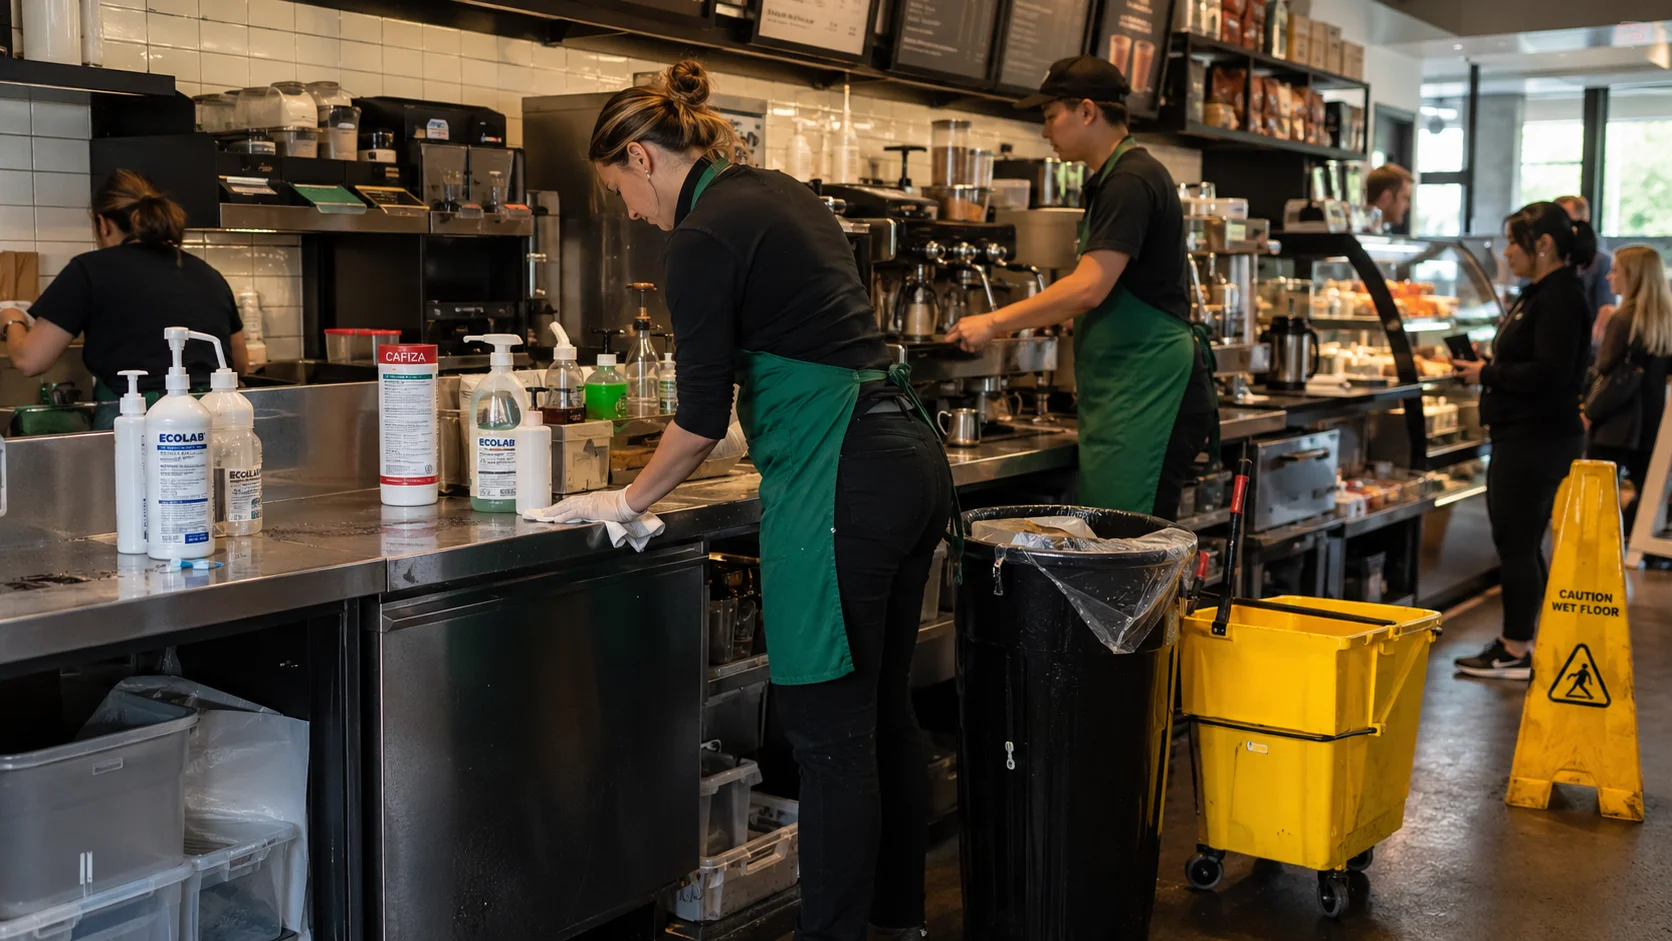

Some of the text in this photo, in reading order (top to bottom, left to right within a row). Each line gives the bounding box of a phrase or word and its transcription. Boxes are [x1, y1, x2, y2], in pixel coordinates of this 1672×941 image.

[385, 351, 427, 363] CAFIZA
[159, 432, 205, 443] ECOLAB
[478, 437, 516, 447] ECOLAB
[1559, 589, 1613, 603] CAUTION
[1551, 601, 1620, 617] WET FLOOR
